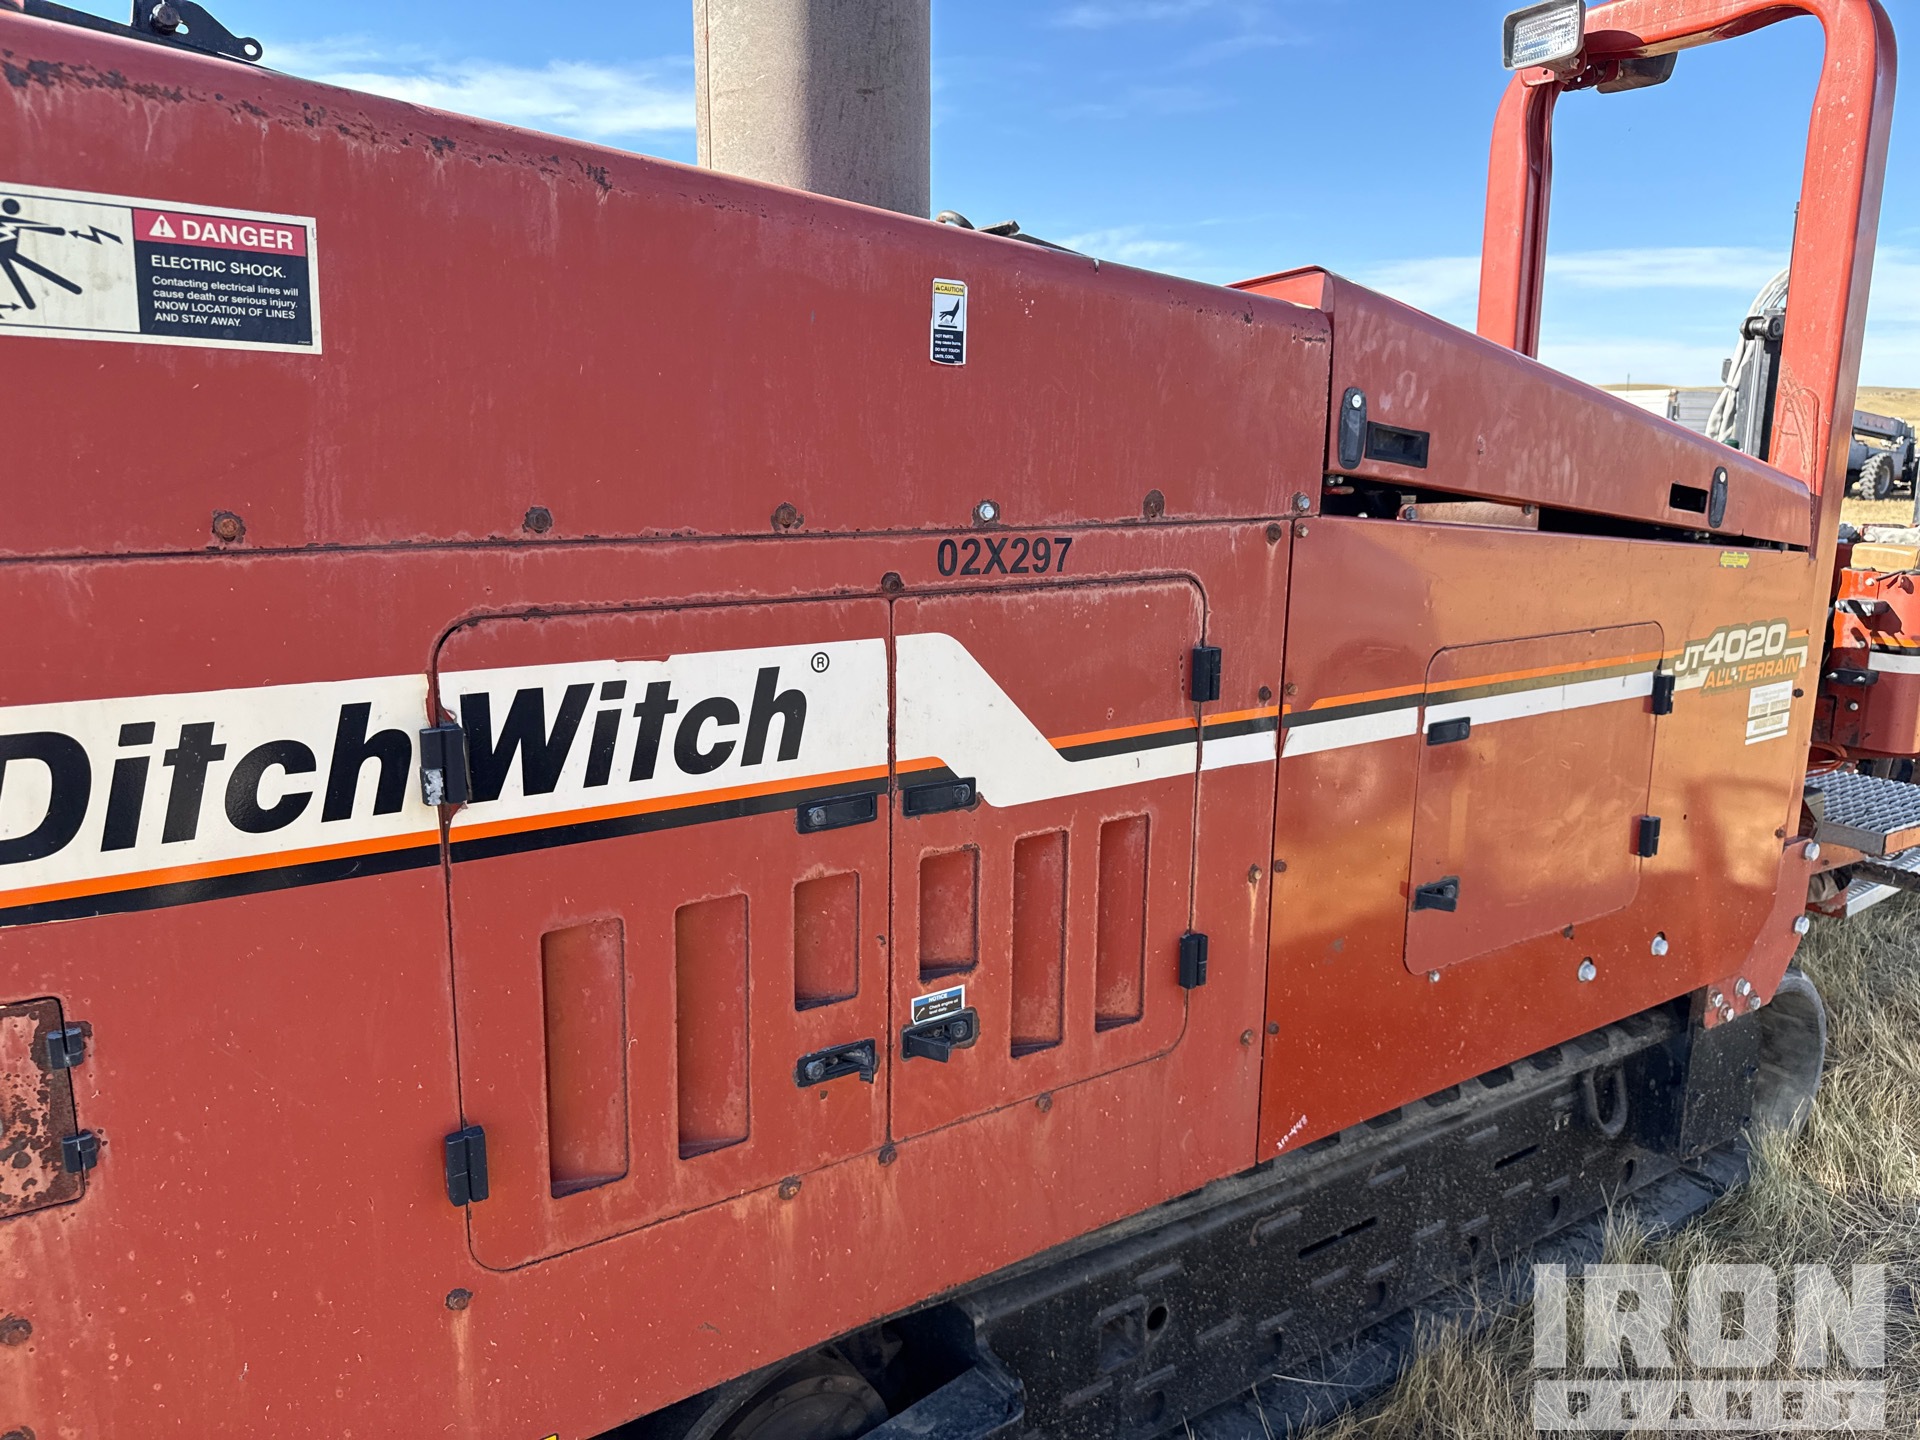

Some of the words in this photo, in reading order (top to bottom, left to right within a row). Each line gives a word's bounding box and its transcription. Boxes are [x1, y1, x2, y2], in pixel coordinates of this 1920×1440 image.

[182, 220, 293, 250] DANGER
[151, 255, 226, 273] ELECTRIC
[230, 262, 287, 278] SHOCK.
[152, 276, 208, 291] Contacting
[211, 281, 255, 293] electrical
[258, 285, 281, 295] lines
[283, 288, 298, 297] will
[940, 285, 963, 293] CAUTION
[153, 290, 184, 299] cause
[187, 291, 215, 302] death
[231, 296, 267, 306] serious
[269, 298, 298, 310] injury.
[154, 300, 189, 311] KNOW
[191, 303, 246, 316] LOCATION
[248, 308, 263, 317] OF
[266, 309, 296, 320] LINES
[155, 312, 179, 323] AND
[182, 314, 208, 325] STAY
[211, 317, 241, 327] AWAY.
[937, 537, 1072, 576] 02X297
[1674, 623, 1787, 672] JT4020
[0, 702, 412, 866] Ditch
[460, 668, 806, 802] Witch
[928, 993, 947, 1003] NOTICE
